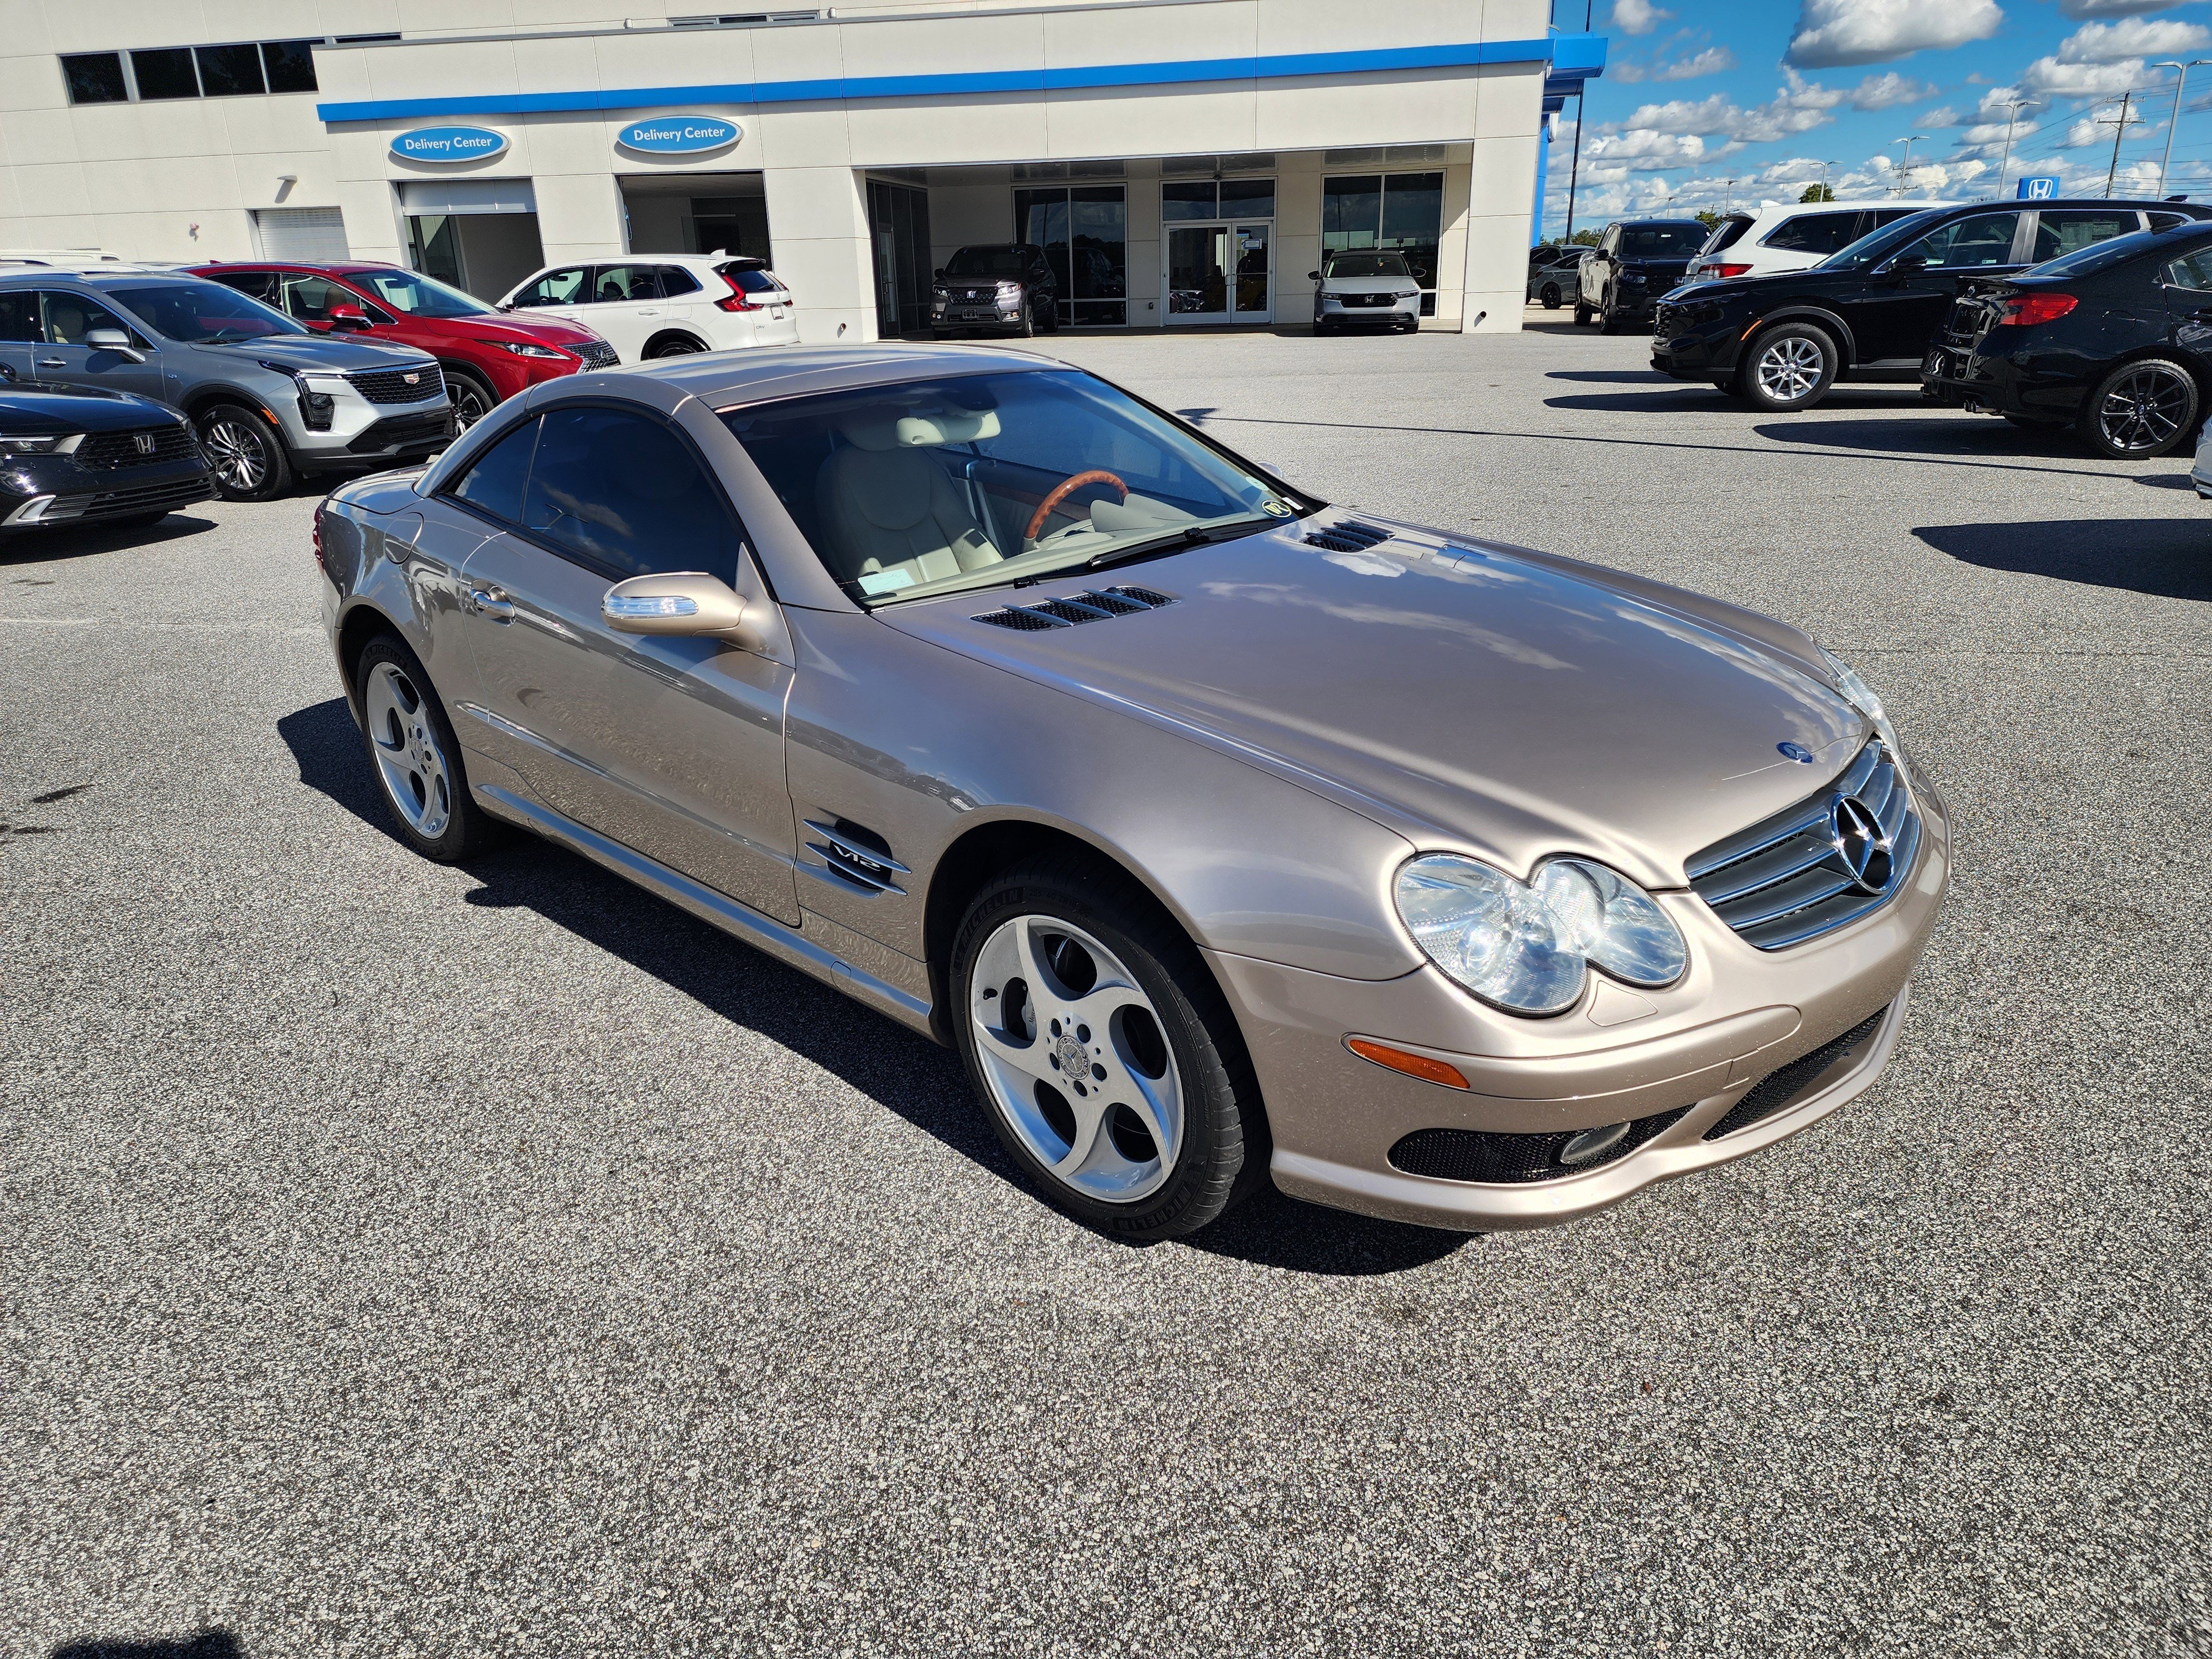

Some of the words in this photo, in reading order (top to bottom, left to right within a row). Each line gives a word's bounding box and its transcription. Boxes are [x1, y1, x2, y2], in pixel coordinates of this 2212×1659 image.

[405, 139, 450, 151] Delivery
[453, 137, 492, 148] Center
[634, 129, 681, 142] Delivery
[685, 127, 726, 139] Center
[833, 844, 880, 872] V12
[960, 889, 1019, 948] MICHELIN
[1118, 1185, 1192, 1231] MICHELIN
